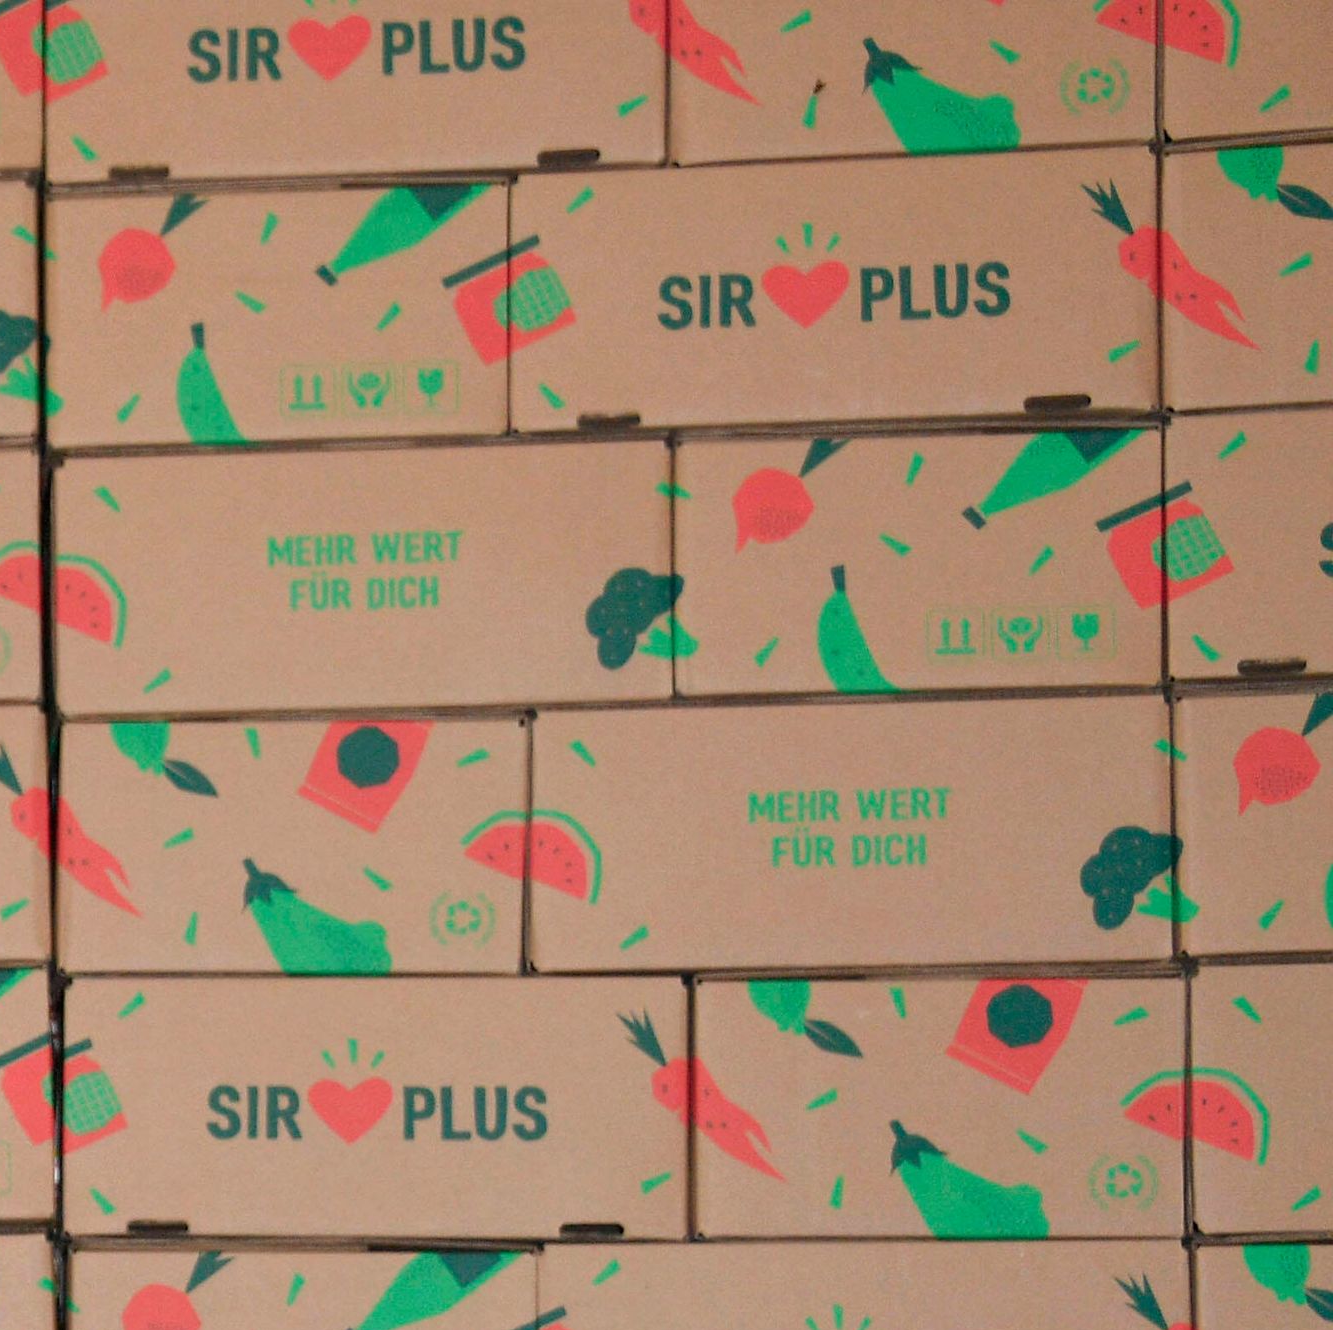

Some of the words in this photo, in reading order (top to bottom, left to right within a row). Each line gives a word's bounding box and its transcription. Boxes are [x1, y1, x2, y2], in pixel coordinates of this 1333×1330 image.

[187, 25, 283, 85] SIR
[382, 15, 528, 76] PLUS
[658, 272, 757, 332] SIR
[860, 261, 1012, 323] PLUS
[266, 533, 357, 568] MEHR
[371, 530, 464, 564] WERT
[289, 570, 352, 611] FÜR
[366, 576, 440, 611] DICH
[747, 789, 840, 824] MEHR
[856, 786, 951, 821] WERT
[771, 827, 836, 868] FÜR
[851, 833, 928, 868] DICH
[207, 1084, 304, 1141] SIR
[403, 1085, 549, 1142] PLUS
